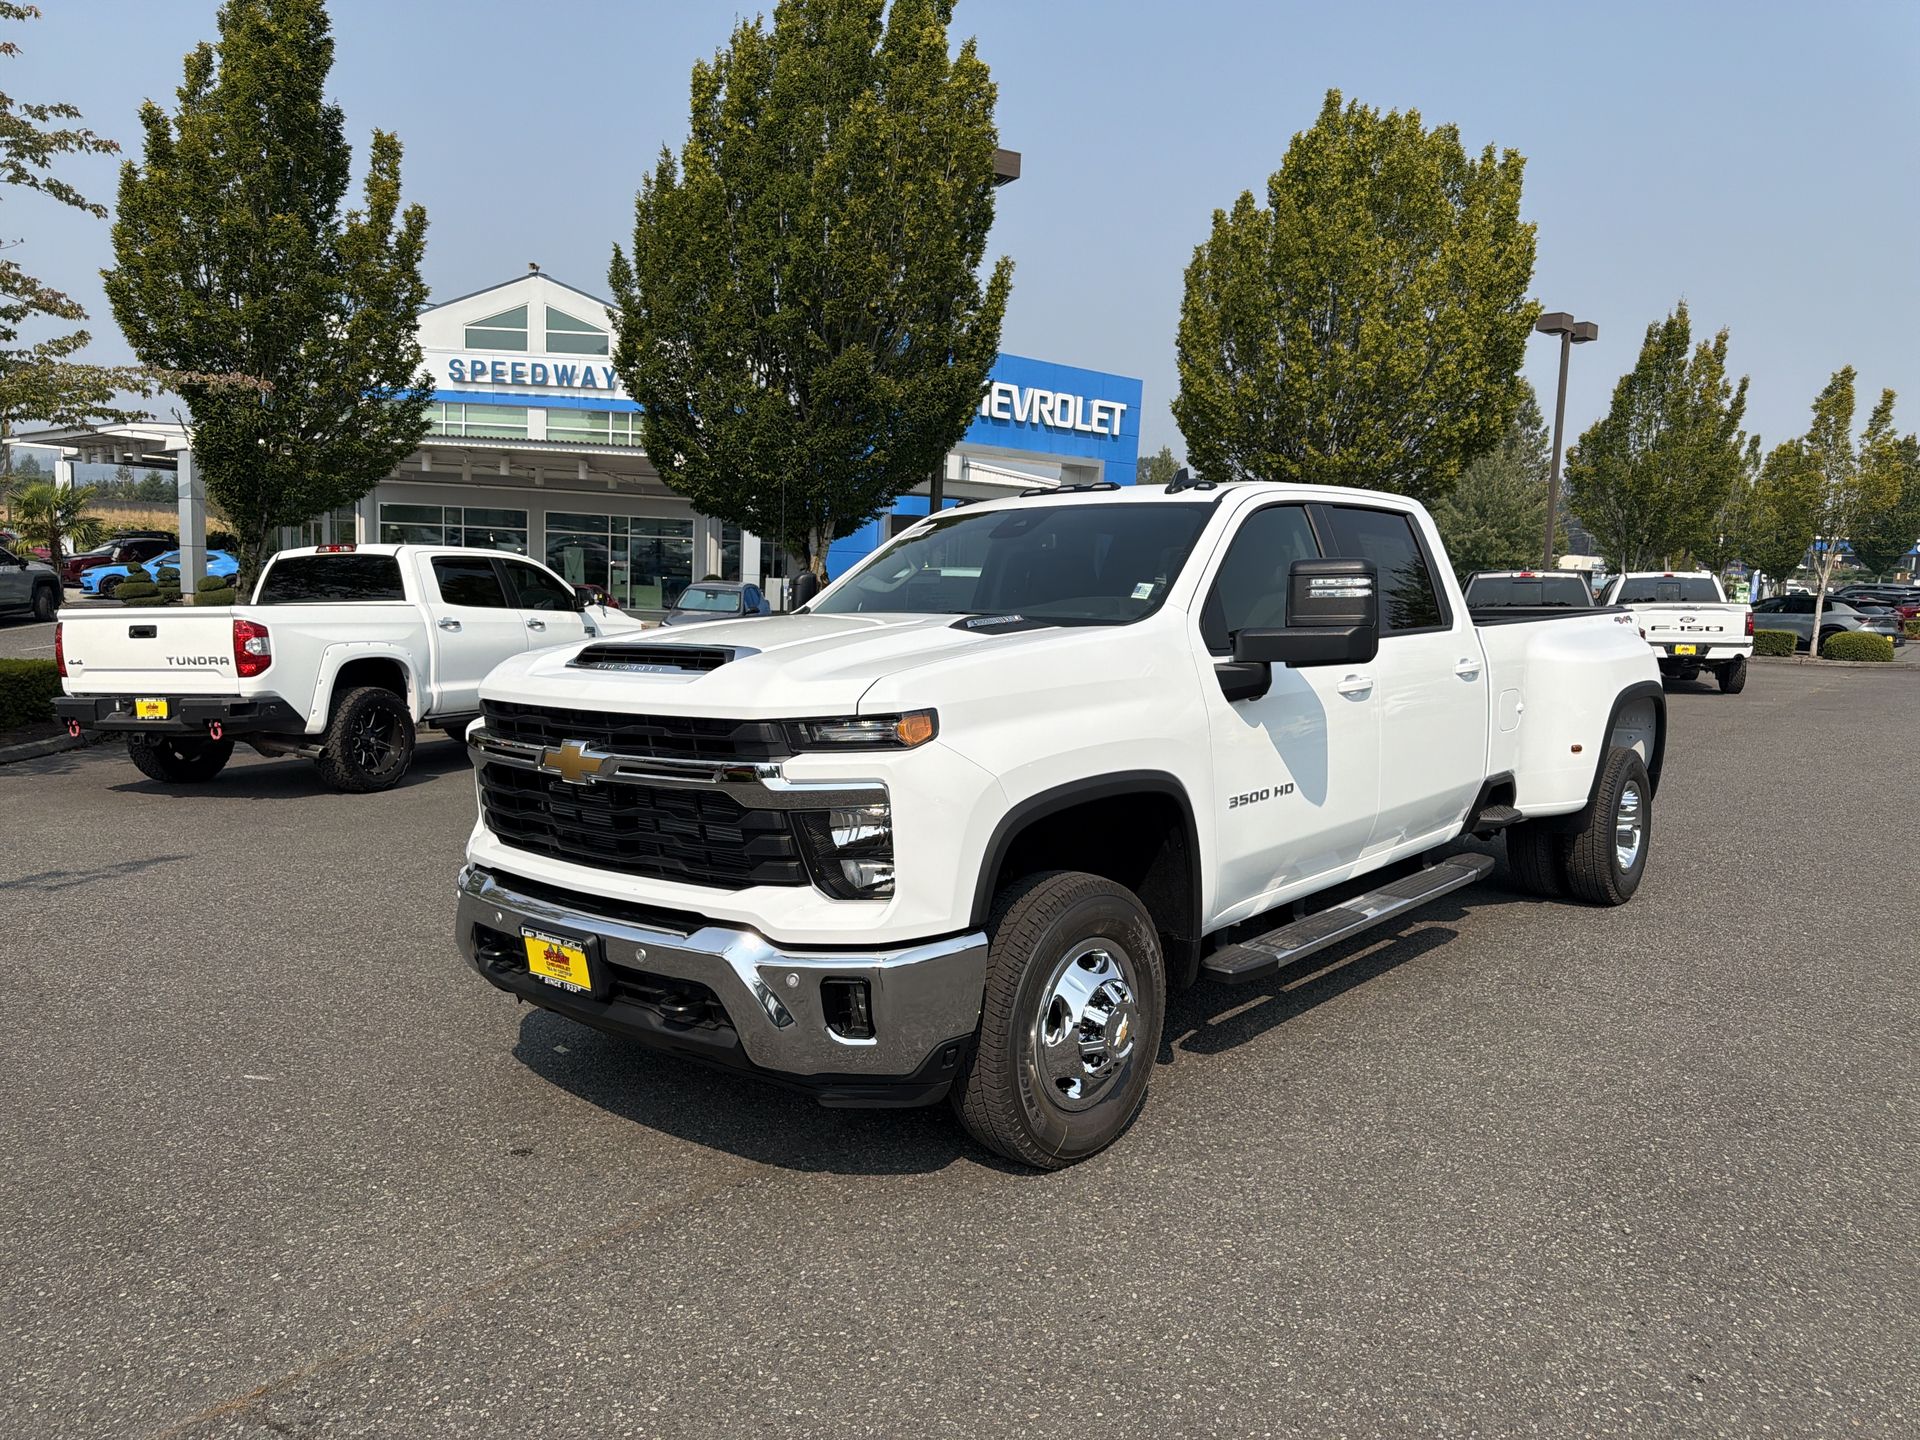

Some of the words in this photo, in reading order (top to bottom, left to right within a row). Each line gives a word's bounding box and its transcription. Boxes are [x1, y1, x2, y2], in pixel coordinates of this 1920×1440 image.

[448, 358, 617, 390] SPEEDWAY
[980, 379, 1127, 436] EVROLET
[166, 656, 230, 666] TUNDRA
[1228, 788, 1270, 810] 3500
[1273, 782, 1294, 798] HD
